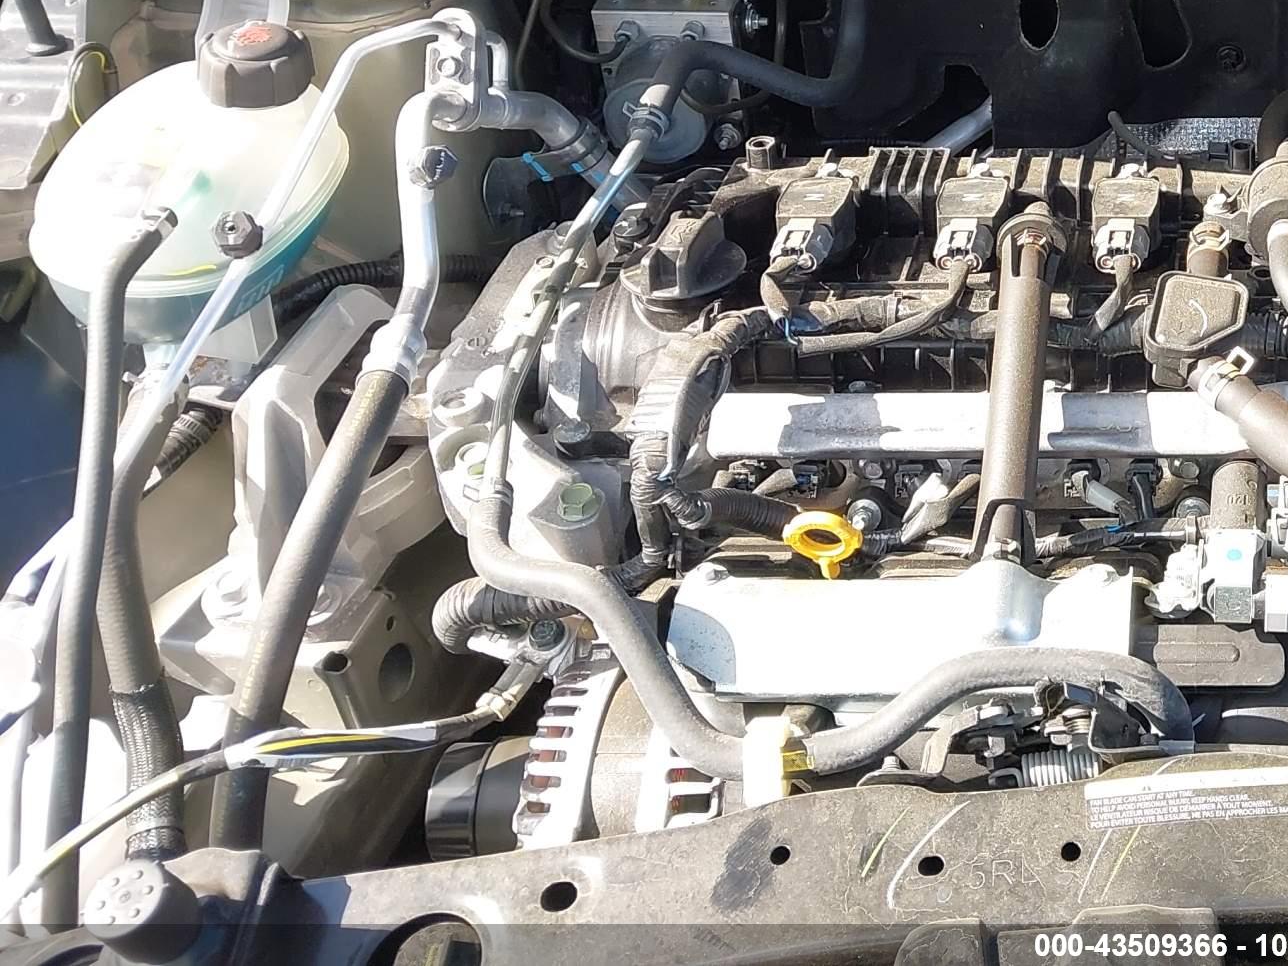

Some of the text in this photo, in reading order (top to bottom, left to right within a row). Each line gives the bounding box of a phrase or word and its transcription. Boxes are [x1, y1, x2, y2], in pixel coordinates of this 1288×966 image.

[1136, 794, 1156, 802] START
[1223, 801, 1240, 809] TOUT
[1241, 799, 1274, 808] MOMENT.
[1135, 816, 1156, 824] TOUTE
